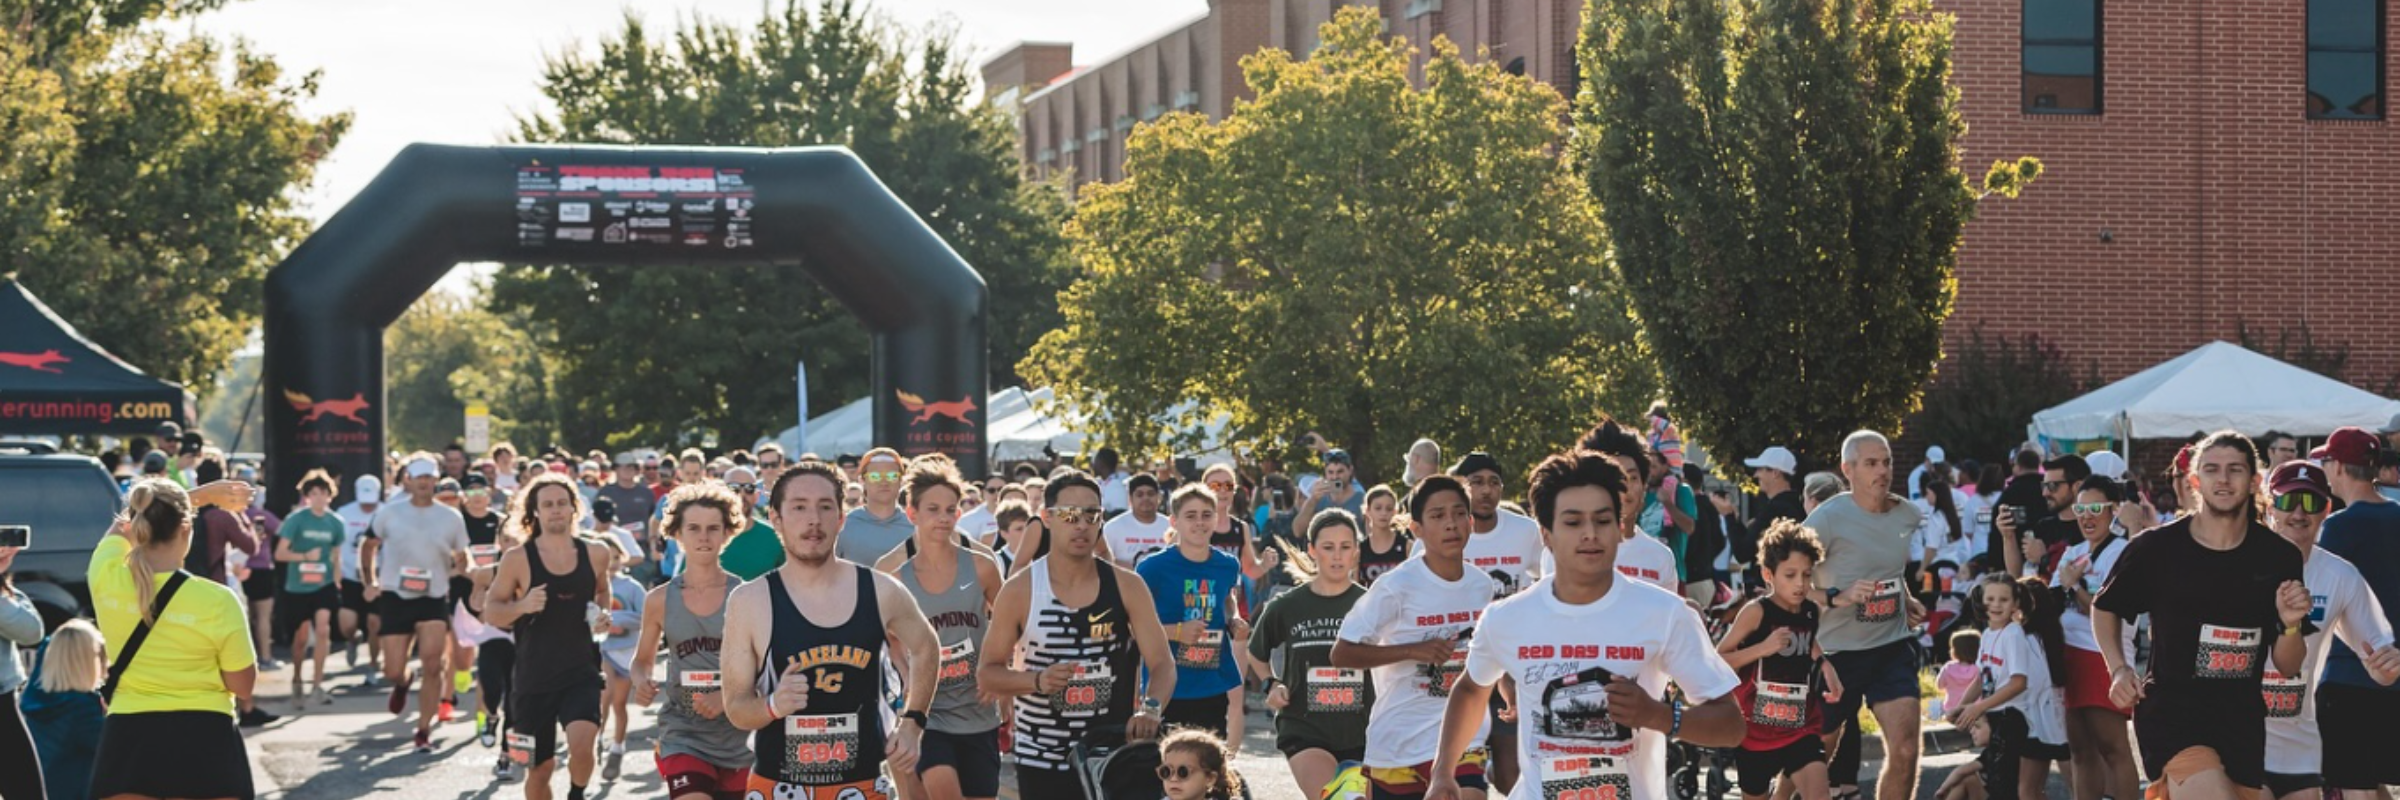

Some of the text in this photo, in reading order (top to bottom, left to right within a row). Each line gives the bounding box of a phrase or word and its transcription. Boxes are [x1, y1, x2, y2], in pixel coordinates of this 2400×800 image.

[0, 400, 172, 423] erunning.com
[1184, 579, 1216, 594] PLAY
[1183, 594, 1216, 607] WITH
[1605, 646, 1645, 661] RUN
[2208, 651, 2249, 671] 309
[815, 668, 843, 692] LC
[1066, 686, 1095, 704] 60
[797, 716, 847, 729] RDR24
[797, 743, 848, 764] 694
[1553, 757, 1614, 773] RDR24
